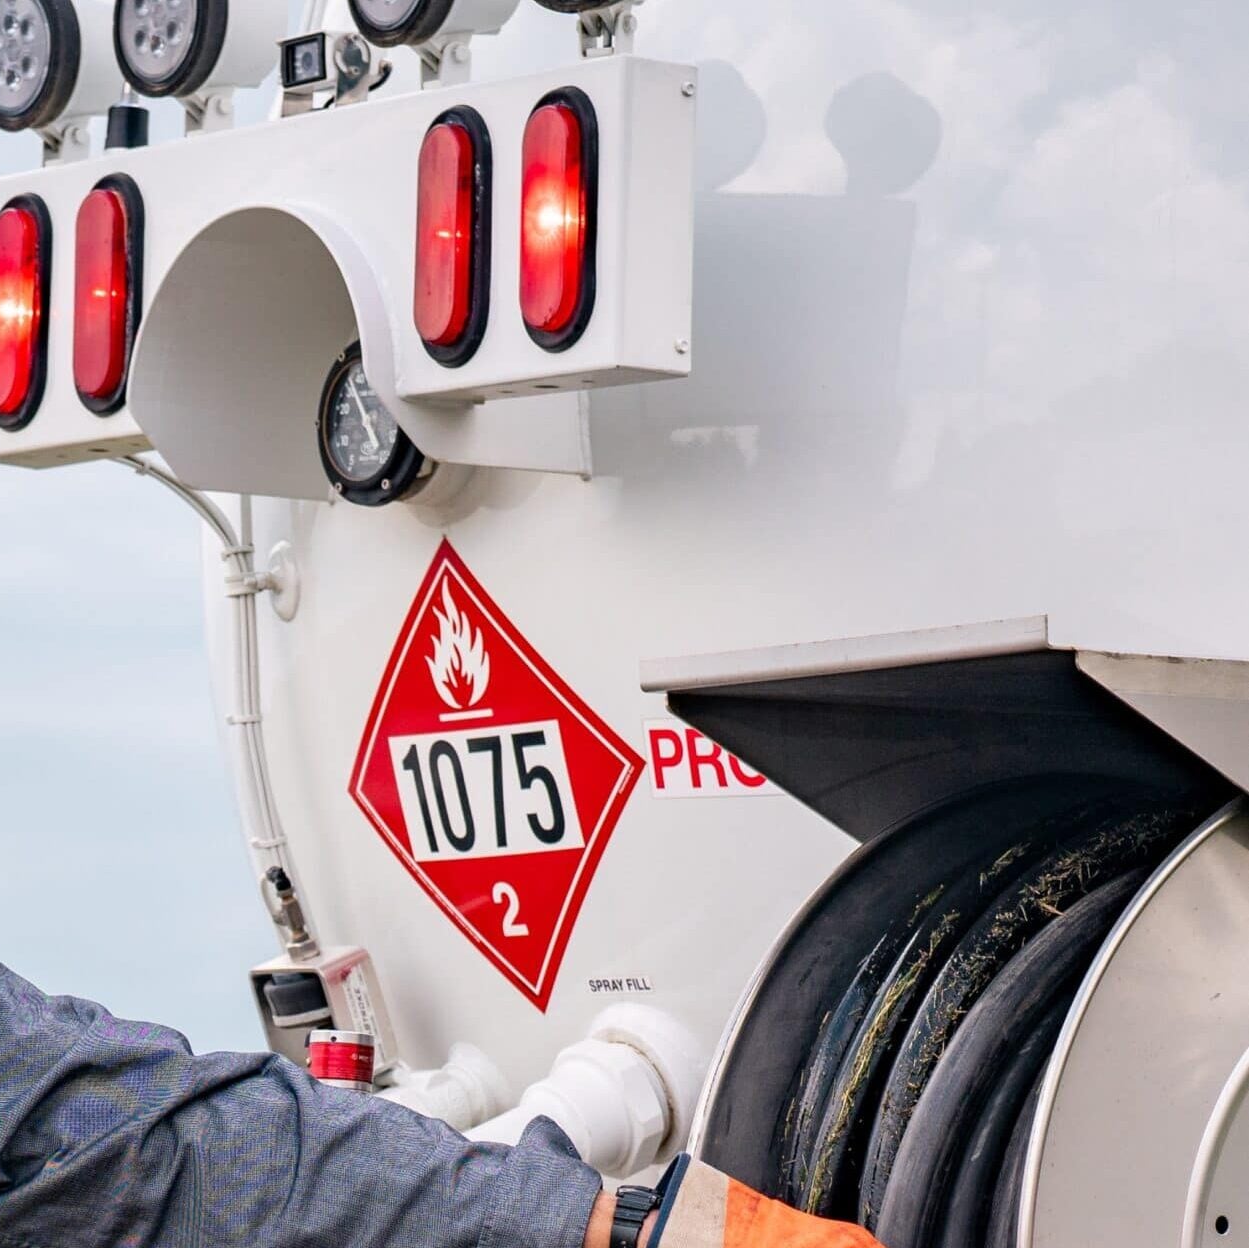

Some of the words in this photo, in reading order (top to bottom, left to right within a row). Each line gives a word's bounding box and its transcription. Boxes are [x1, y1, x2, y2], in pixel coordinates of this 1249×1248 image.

[402, 730, 565, 854] 1075
[491, 881, 529, 938] 2
[588, 979, 624, 992] SPRAY
[625, 978, 651, 991] FILL
